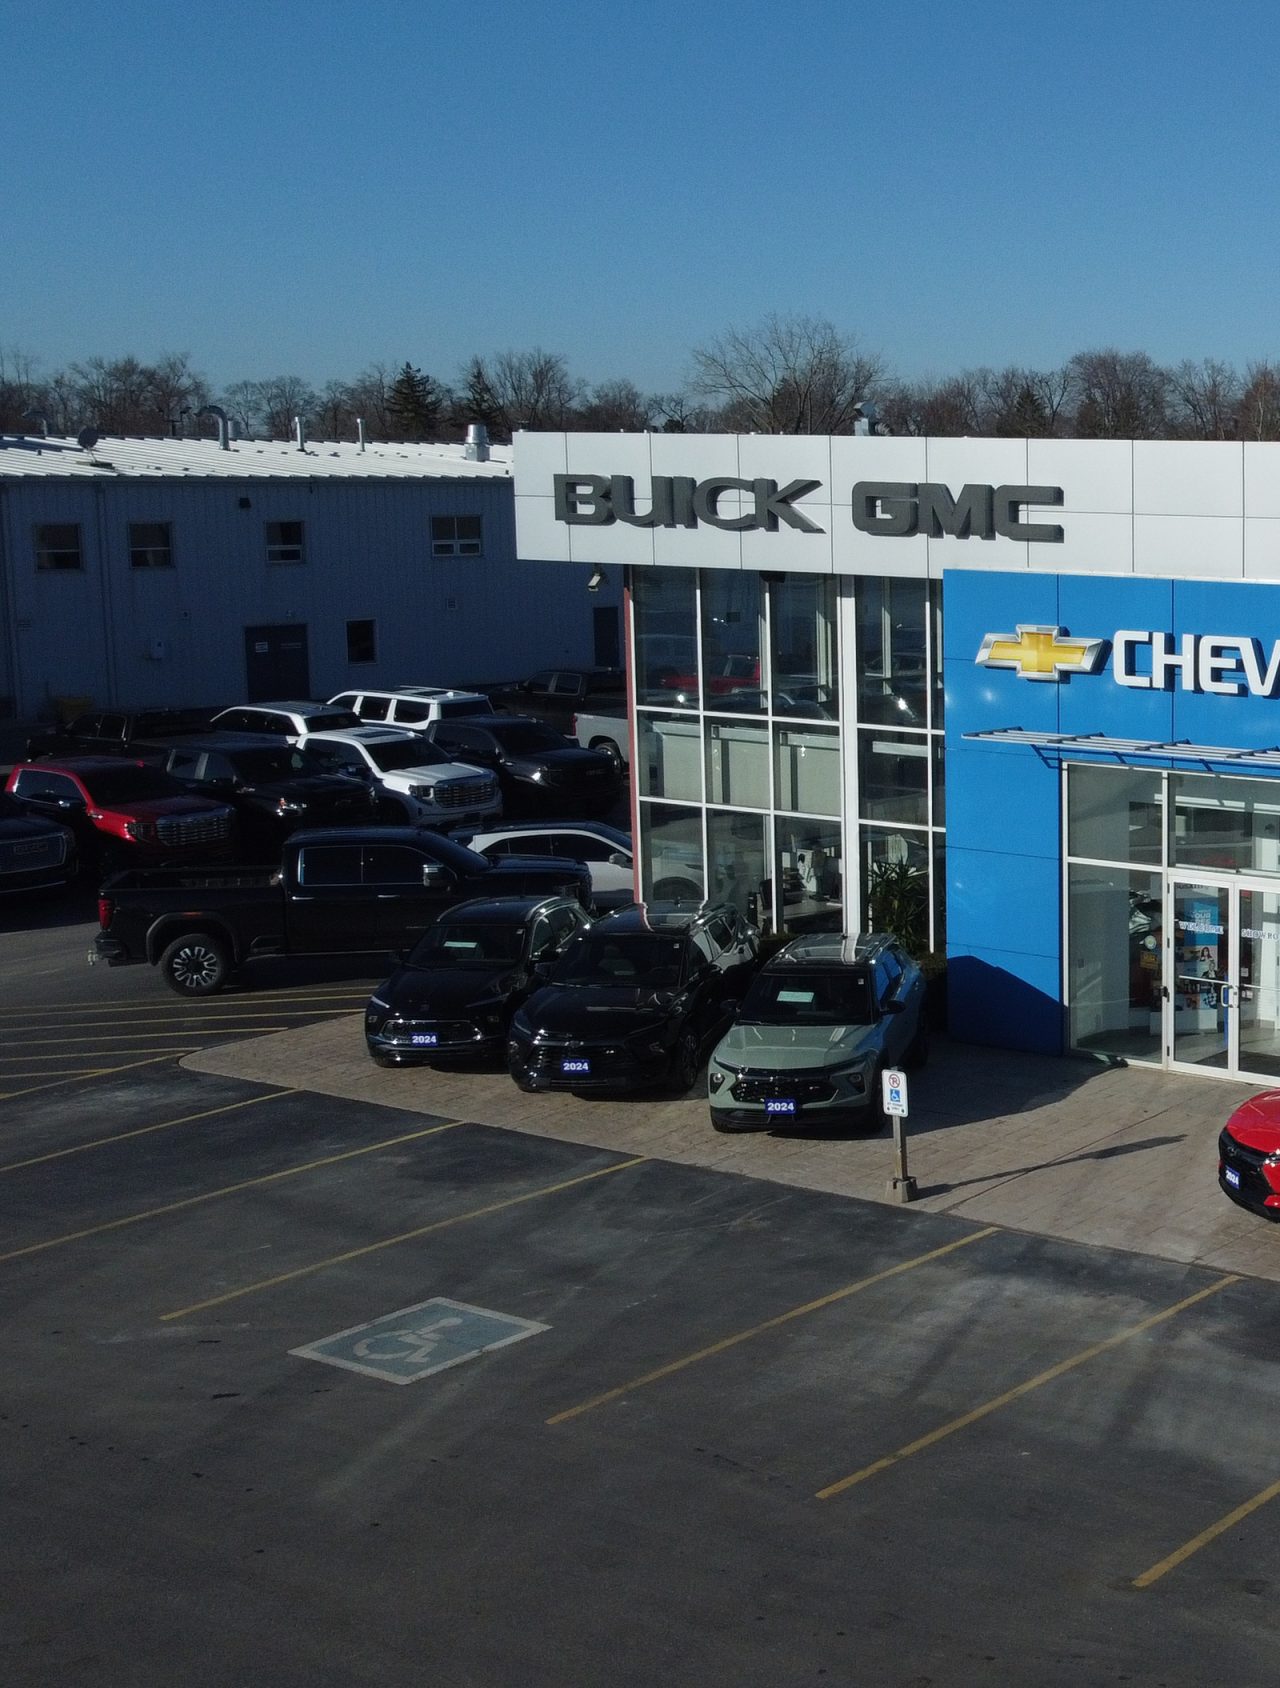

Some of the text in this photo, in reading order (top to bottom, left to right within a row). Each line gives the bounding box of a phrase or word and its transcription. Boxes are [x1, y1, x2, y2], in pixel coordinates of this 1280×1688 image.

[554, 473, 825, 534] BUICK
[851, 480, 1065, 543] GMC
[412, 1035, 437, 1045] 2024
[563, 1061, 589, 1072] 2024
[767, 1102, 795, 1112] 2024
[1225, 1170, 1239, 1186] 2024
